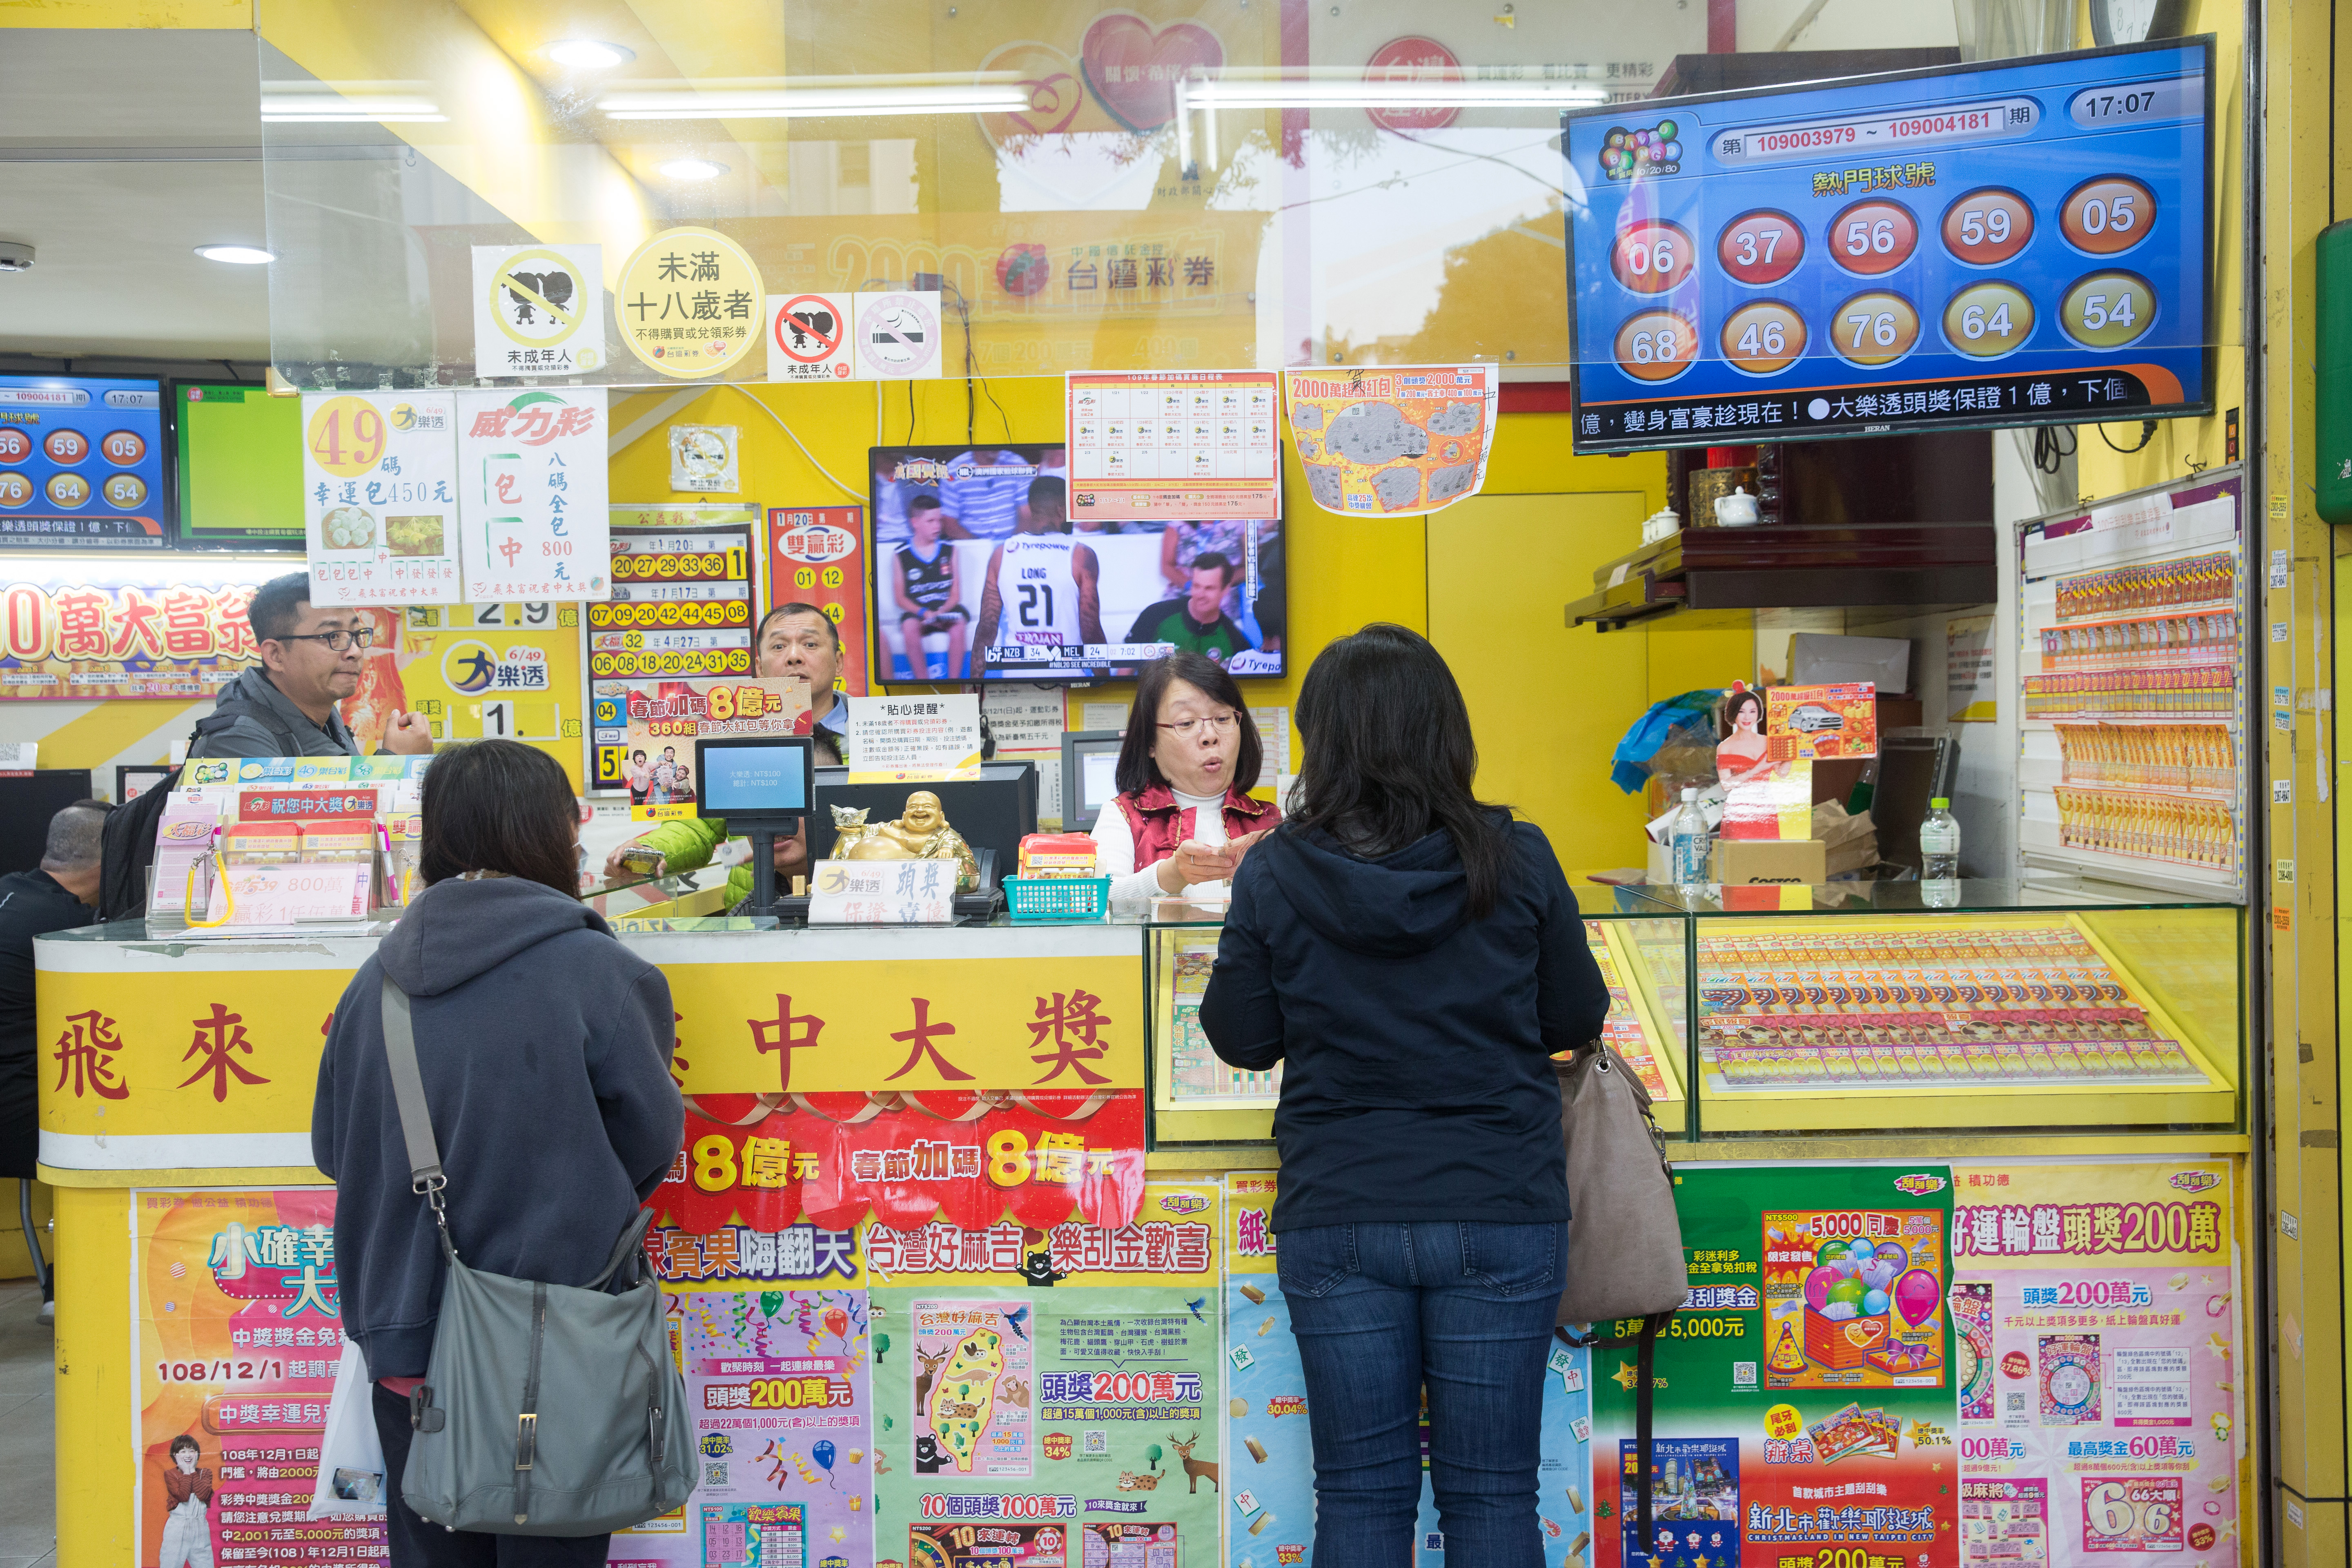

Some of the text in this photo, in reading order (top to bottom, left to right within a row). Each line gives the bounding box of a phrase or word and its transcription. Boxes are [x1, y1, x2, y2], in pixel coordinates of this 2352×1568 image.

[1606, 62, 1653, 78] 更精彩
[2085, 92, 2155, 117] 17:07
[1757, 127, 1855, 152] 109003979
[1889, 112, 1991, 138] 109004181
[2009, 107, 2030, 125] 期
[1812, 162, 1936, 197] 熱門球號
[1628, 196, 2136, 276] 06 37 56 59 05
[659, 251, 720, 282] 未滿
[628, 290, 753, 321] 十八歲者
[636, 326, 747, 340] 不得購買或兌領彩券
[1631, 293, 2135, 365] 68 46 76 64 54
[508, 349, 572, 363] 未成年人
[787, 364, 832, 374] 未成年人
[16, 392, 67, 402] 109004181
[111, 394, 143, 405] 17:07
[314, 409, 384, 465] 49
[53, 438, 136, 456] 59 05
[55, 482, 138, 500] 64 54
[543, 541, 572, 557] 800
[787, 534, 844, 555] 雙贏彩
[615, 558, 720, 572] 20 27 29 33 36
[797, 571, 839, 585] 01 12
[1022, 568, 1046, 579] LONG
[1018, 585, 1053, 627] 21
[558, 609, 579, 627] 億
[593, 606, 745, 622] 07 09 20 42 44 45 08
[626, 635, 641, 647] 32
[510, 649, 541, 662] 6/49
[1004, 647, 1100, 657] NZB 34 MEL 24
[1120, 646, 1135, 655] 7:02
[455, 650, 545, 686] 大樂透
[596, 653, 747, 670] 06 08 18 20 24 31 35
[597, 704, 616, 719] 04
[562, 719, 582, 737] 億
[271, 796, 343, 814] 祝您中大獎
[861, 869, 881, 879] 6/49
[1236, 1180, 1276, 1194] 買彩券
[1969, 1174, 2010, 1187] 積功德
[1693, 1250, 1740, 1261] 彩迷利多
[1767, 1251, 1812, 1262] 限定發售
[2023, 1282, 2149, 1305] 頭獎200萬元
[159, 1360, 282, 1381] 108/12/1
[721, 1360, 835, 1373] 歡聚時刻 一起連線最樂
[707, 1379, 851, 1409] 頭獎200萬元
[1042, 1374, 1201, 1402] 頭獎200萬元
[1267, 1403, 1307, 1415] 30.04%
[1918, 1436, 1952, 1446] 50.1%
[2068, 1434, 2193, 1457] 最高獎金60萬元
[221, 1448, 318, 1461] 108年12月1日起
[699, 1445, 733, 1454] 31.02%
[1045, 1446, 1071, 1459] 34%
[922, 1496, 1076, 1517] 10個頭獎100萬元
[1748, 1533, 1828, 1541] CHRISTMASLAND
[1278, 1552, 1302, 1564] 33%
